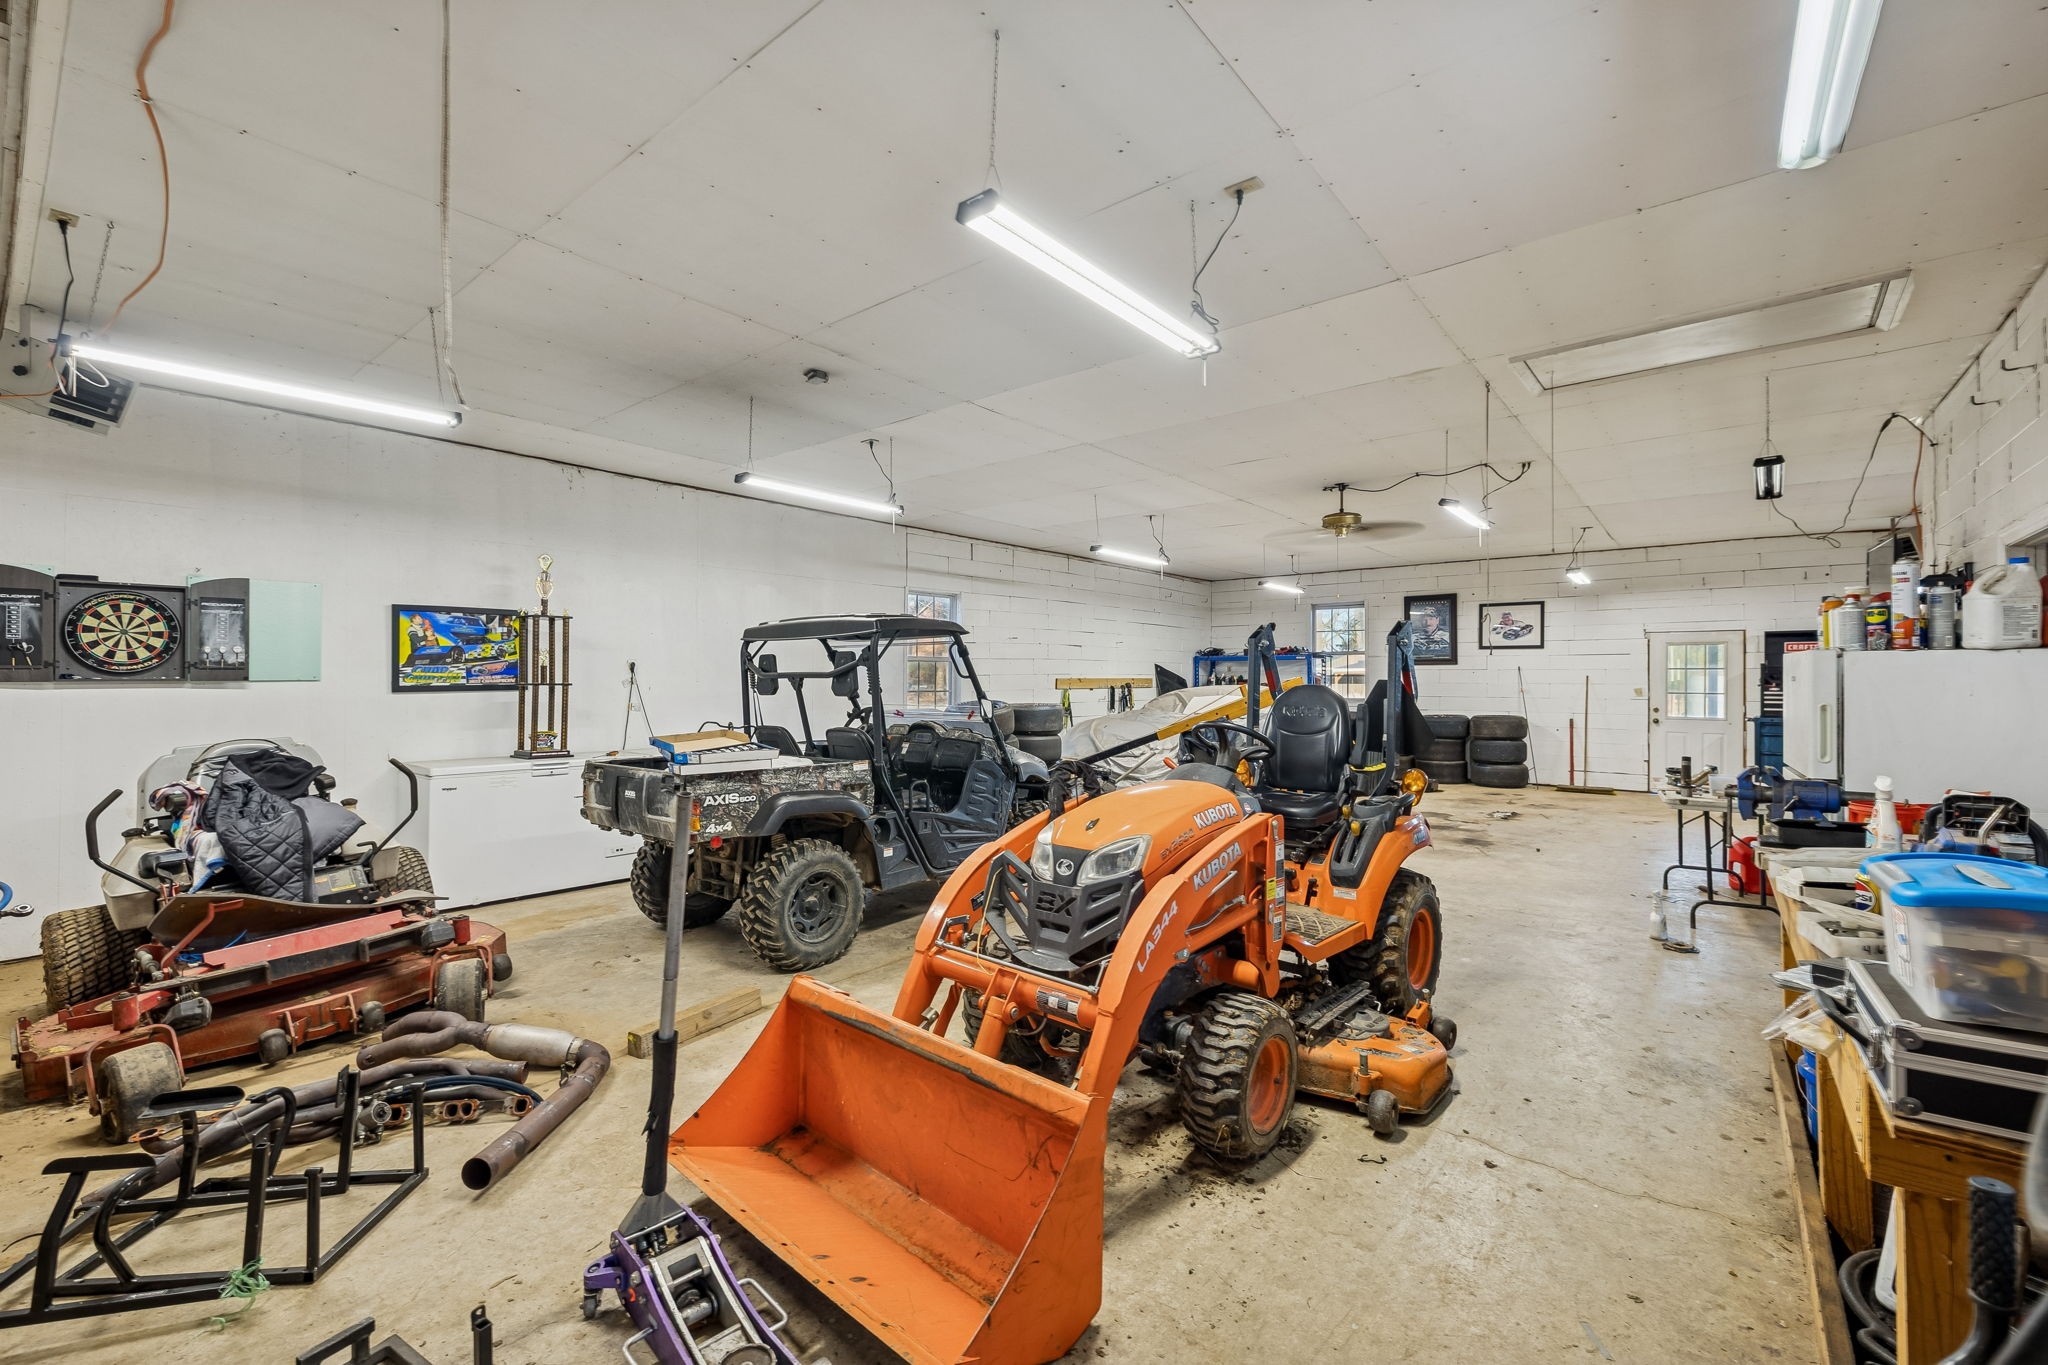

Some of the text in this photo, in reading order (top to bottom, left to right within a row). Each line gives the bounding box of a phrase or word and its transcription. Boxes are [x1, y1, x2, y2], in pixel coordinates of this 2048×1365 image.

[705, 821, 733, 834] 4x4
[1192, 801, 1238, 830] KUBOTA
[1192, 841, 1243, 892] KUBOTA
[1035, 891, 1077, 917] BX
[1136, 899, 1179, 973] LA344
